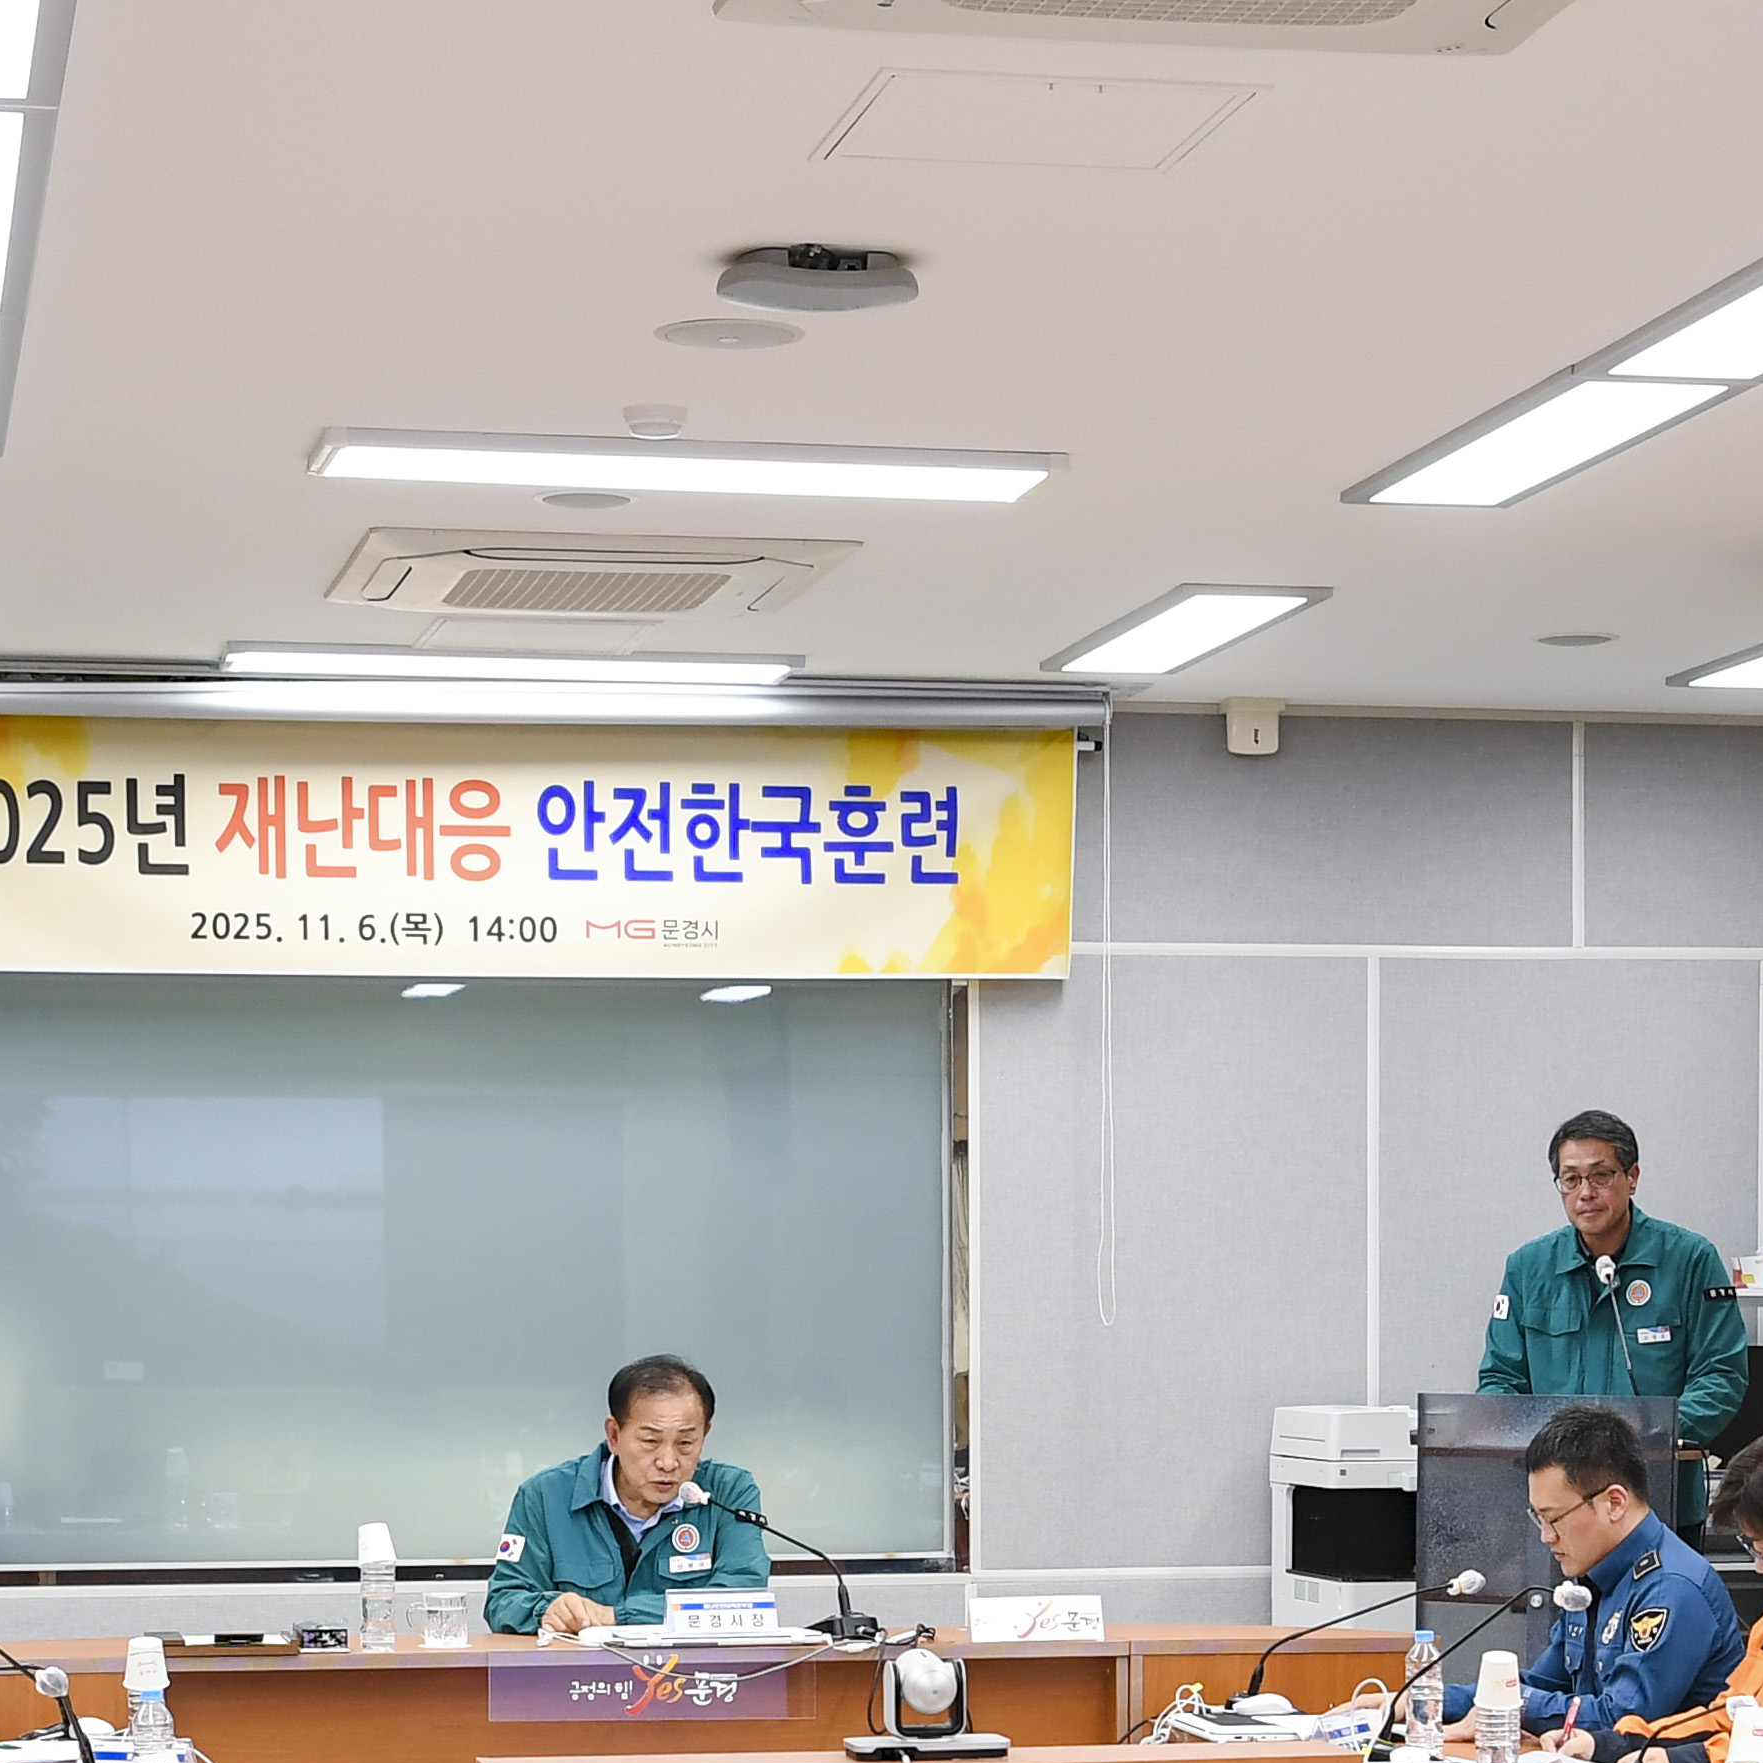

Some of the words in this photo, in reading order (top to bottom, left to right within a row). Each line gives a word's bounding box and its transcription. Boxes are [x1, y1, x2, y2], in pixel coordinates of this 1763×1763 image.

[217, 774, 513, 883] 재난대응
[537, 781, 959, 887] 안전한국훈련
[190, 911, 283, 942] 2025.
[298, 913, 345, 943] 11.
[358, 913, 443, 946] 6.(목)
[468, 914, 558, 944] 14:00
[661, 919, 719, 941] 문경시
[688, 1613, 764, 1628] 문경시장
[1061, 1611, 1100, 1632] 문경
[569, 1681, 611, 1701] 긍정의
[613, 1680, 634, 1700] 힘!
[624, 1653, 687, 1716] Yes
[684, 1671, 739, 1706] 문경
